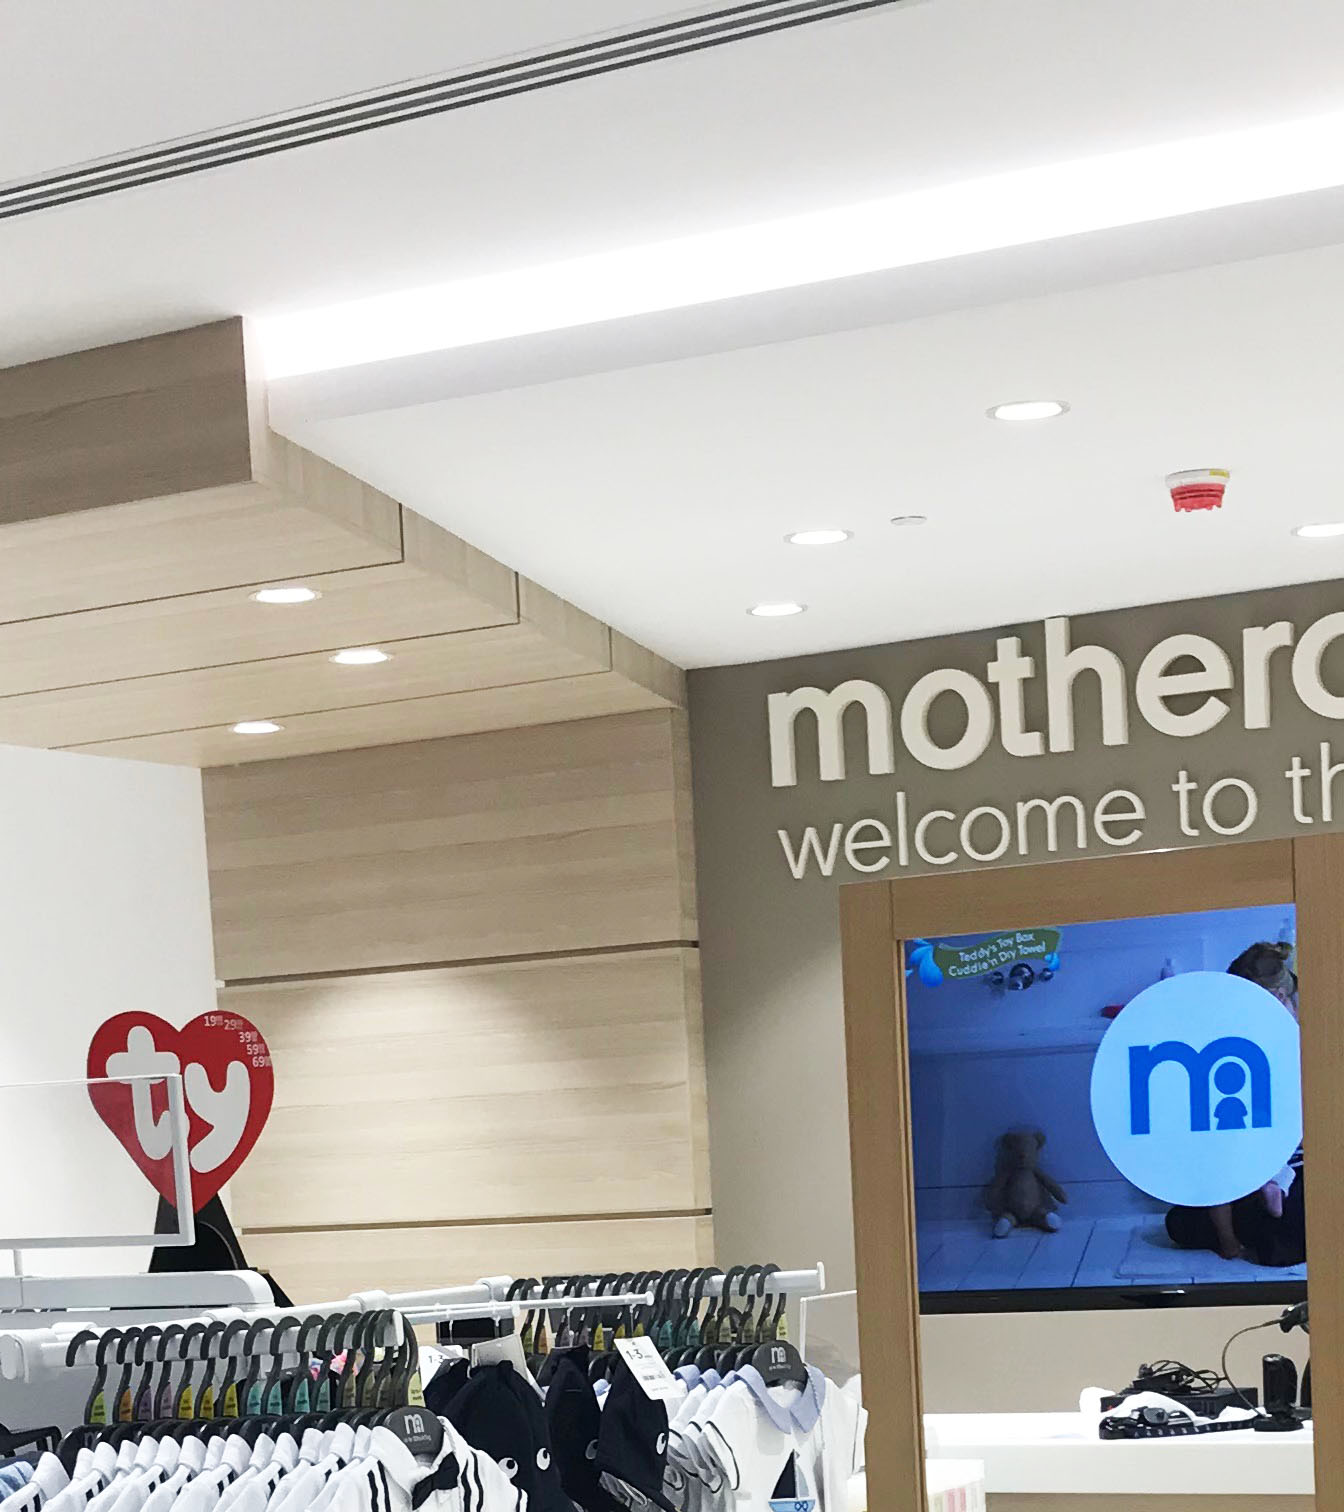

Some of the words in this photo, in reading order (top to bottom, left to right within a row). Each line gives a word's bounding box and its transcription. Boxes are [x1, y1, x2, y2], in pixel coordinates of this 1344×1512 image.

[777, 789, 1146, 880] welcome
[1171, 768, 1258, 837] to
[948, 962, 989, 977] Cuddle
[1000, 951, 1017, 963] Dry
[1019, 941, 1046, 955] Towel
[959, 945, 998, 963] Teddy's
[997, 937, 1014, 949] Toy
[1016, 932, 1035, 944] Box
